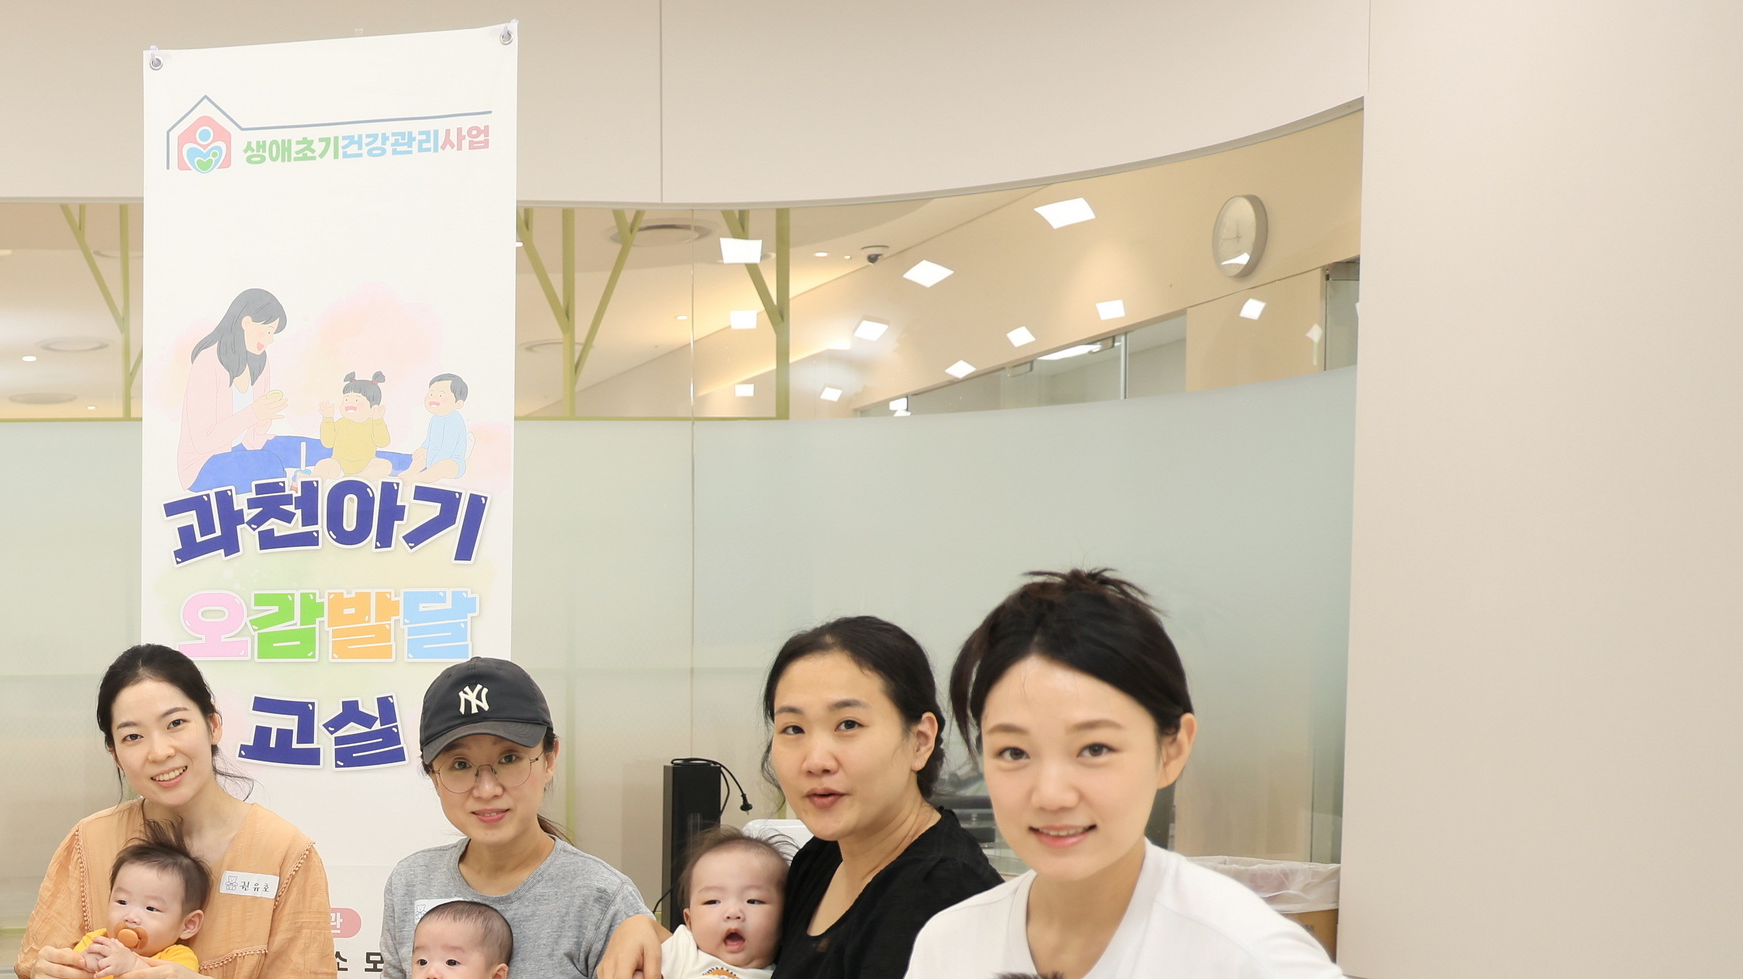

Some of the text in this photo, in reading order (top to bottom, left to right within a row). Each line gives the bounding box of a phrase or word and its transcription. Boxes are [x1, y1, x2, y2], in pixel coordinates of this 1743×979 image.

[242, 124, 490, 165] 생애초기건강관리사업
[161, 479, 490, 567] 과천아기
[177, 590, 480, 661] 오감발달
[237, 695, 409, 771] 교실
